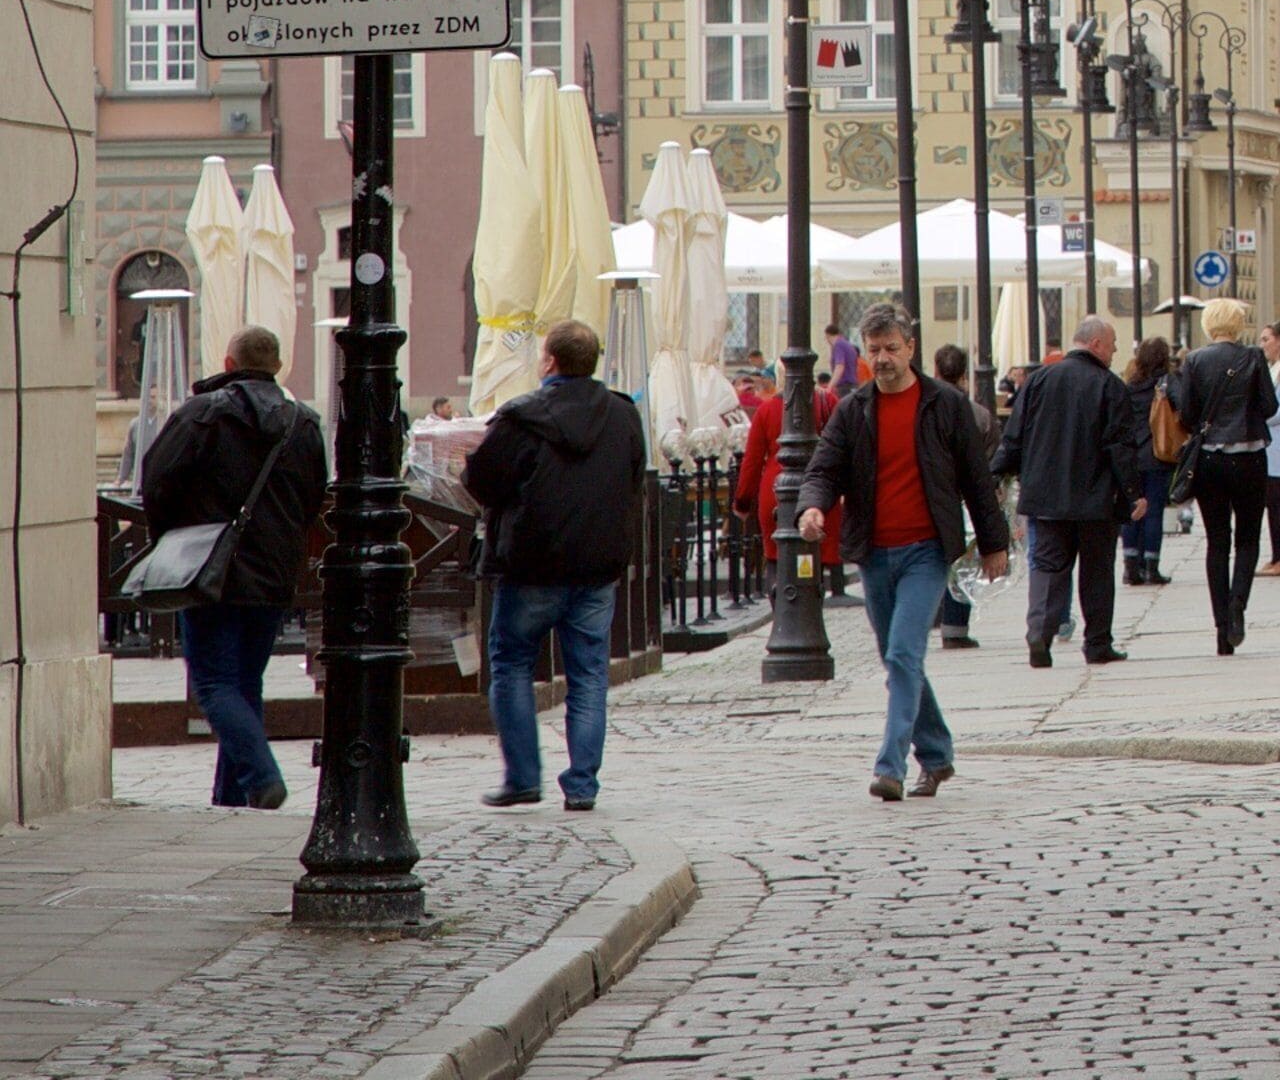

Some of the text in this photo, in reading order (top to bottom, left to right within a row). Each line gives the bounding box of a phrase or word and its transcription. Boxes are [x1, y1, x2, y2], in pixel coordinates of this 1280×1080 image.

[368, 21, 420, 41] przez
[434, 15, 480, 35] ZDM
[1065, 227, 1083, 240] WC
